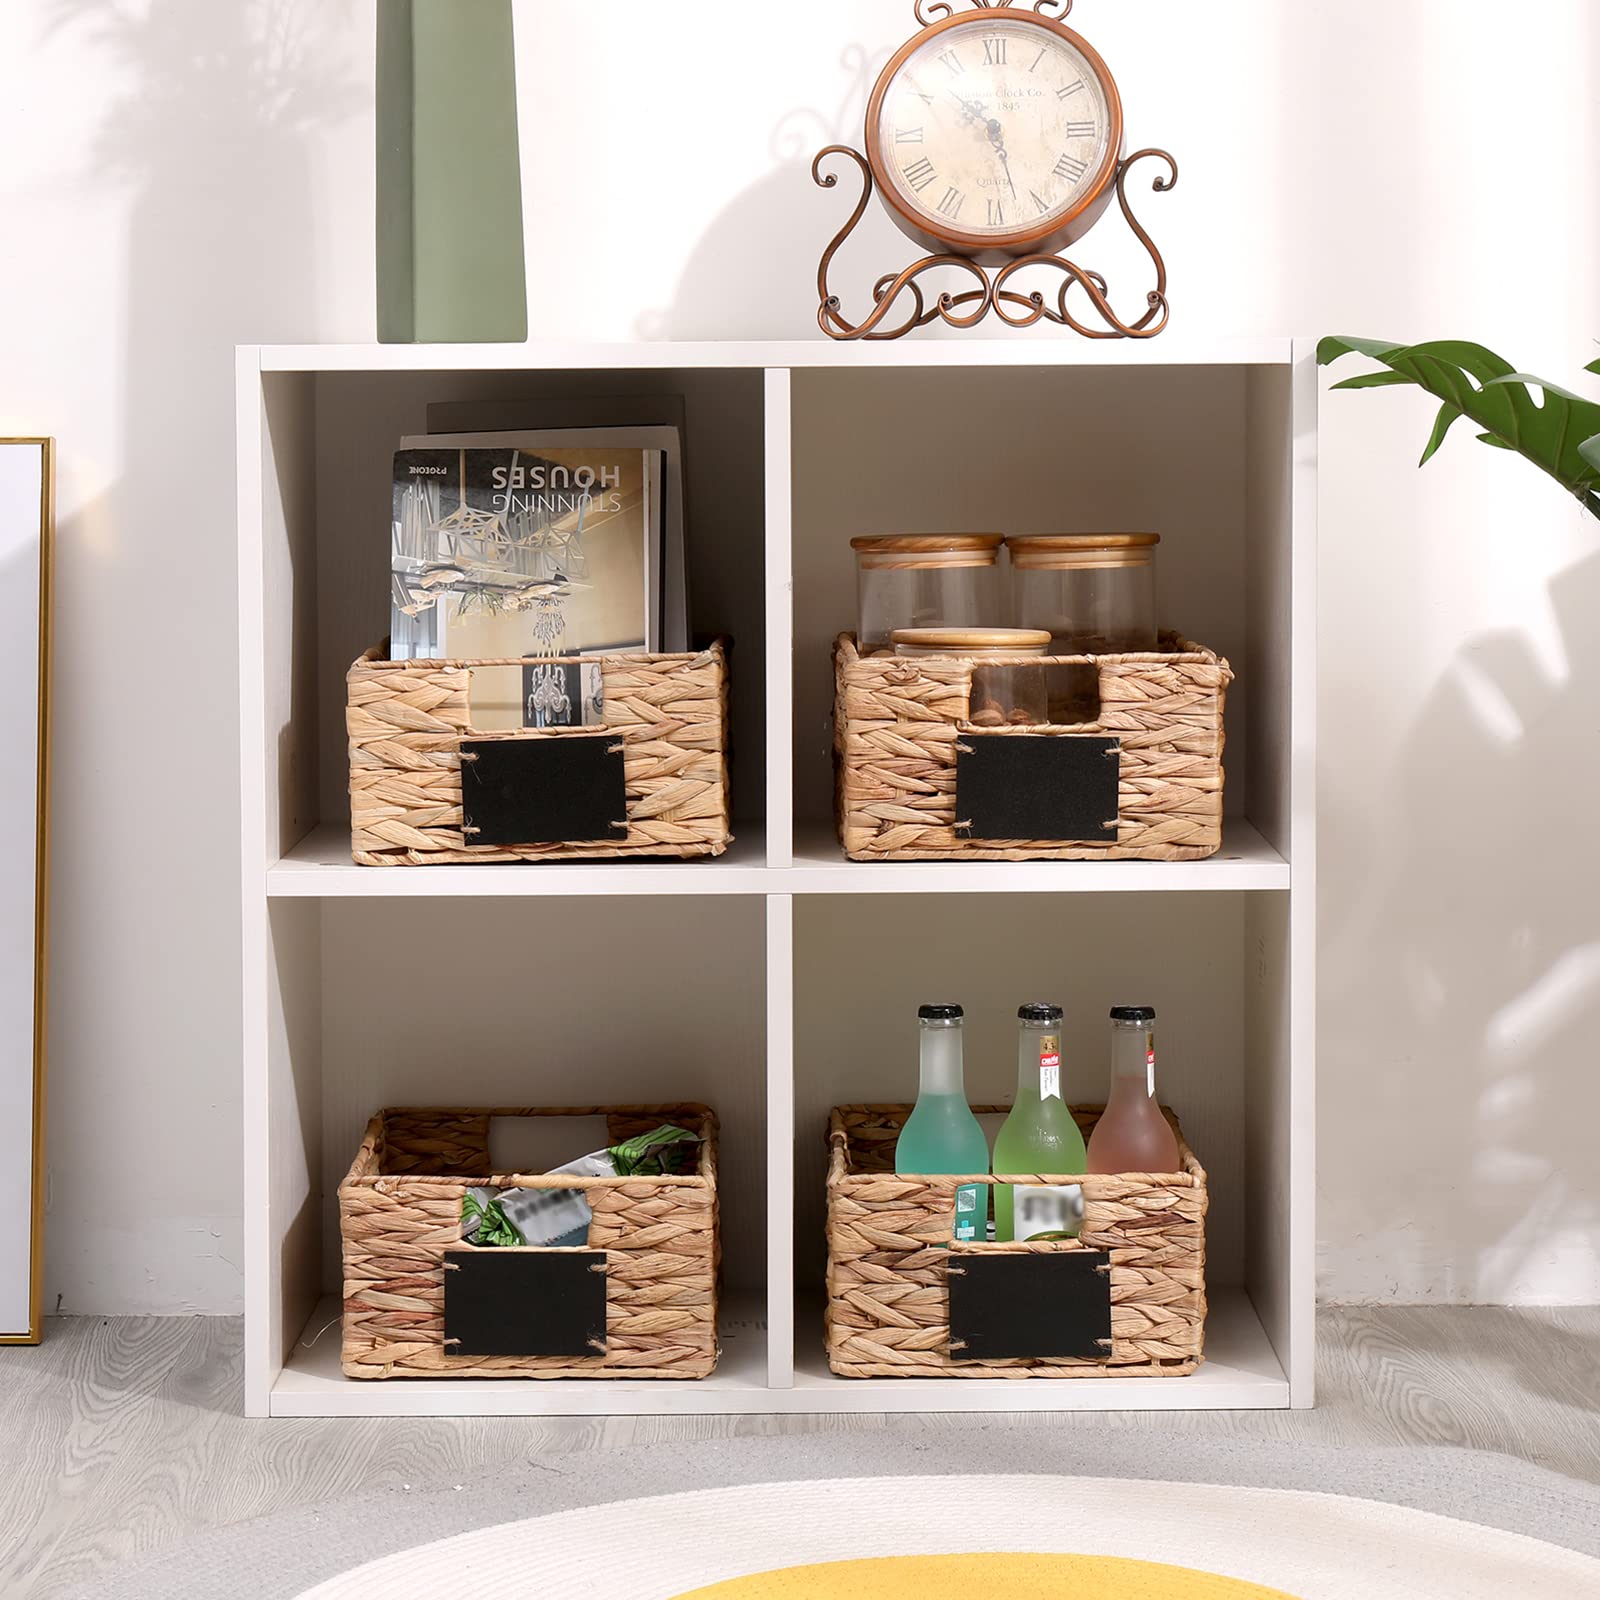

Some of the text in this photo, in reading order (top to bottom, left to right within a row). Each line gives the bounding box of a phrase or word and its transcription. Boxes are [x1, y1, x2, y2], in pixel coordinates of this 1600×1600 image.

[938, 49, 965, 75] XI
[982, 39, 1007, 65] XII
[995, 87, 1024, 98] Clock
[1055, 79, 1085, 101] II
[998, 102, 1021, 112] 1845
[895, 126, 923, 144] IX
[1066, 120, 1095, 139] III
[902, 156, 937, 193] VIII
[936, 187, 967, 220] VII
[986, 199, 1005, 226] VI
[1029, 190, 1050, 214] V
[491, 465, 621, 489] HOUSES
[492, 492, 622, 513] STUNNING
